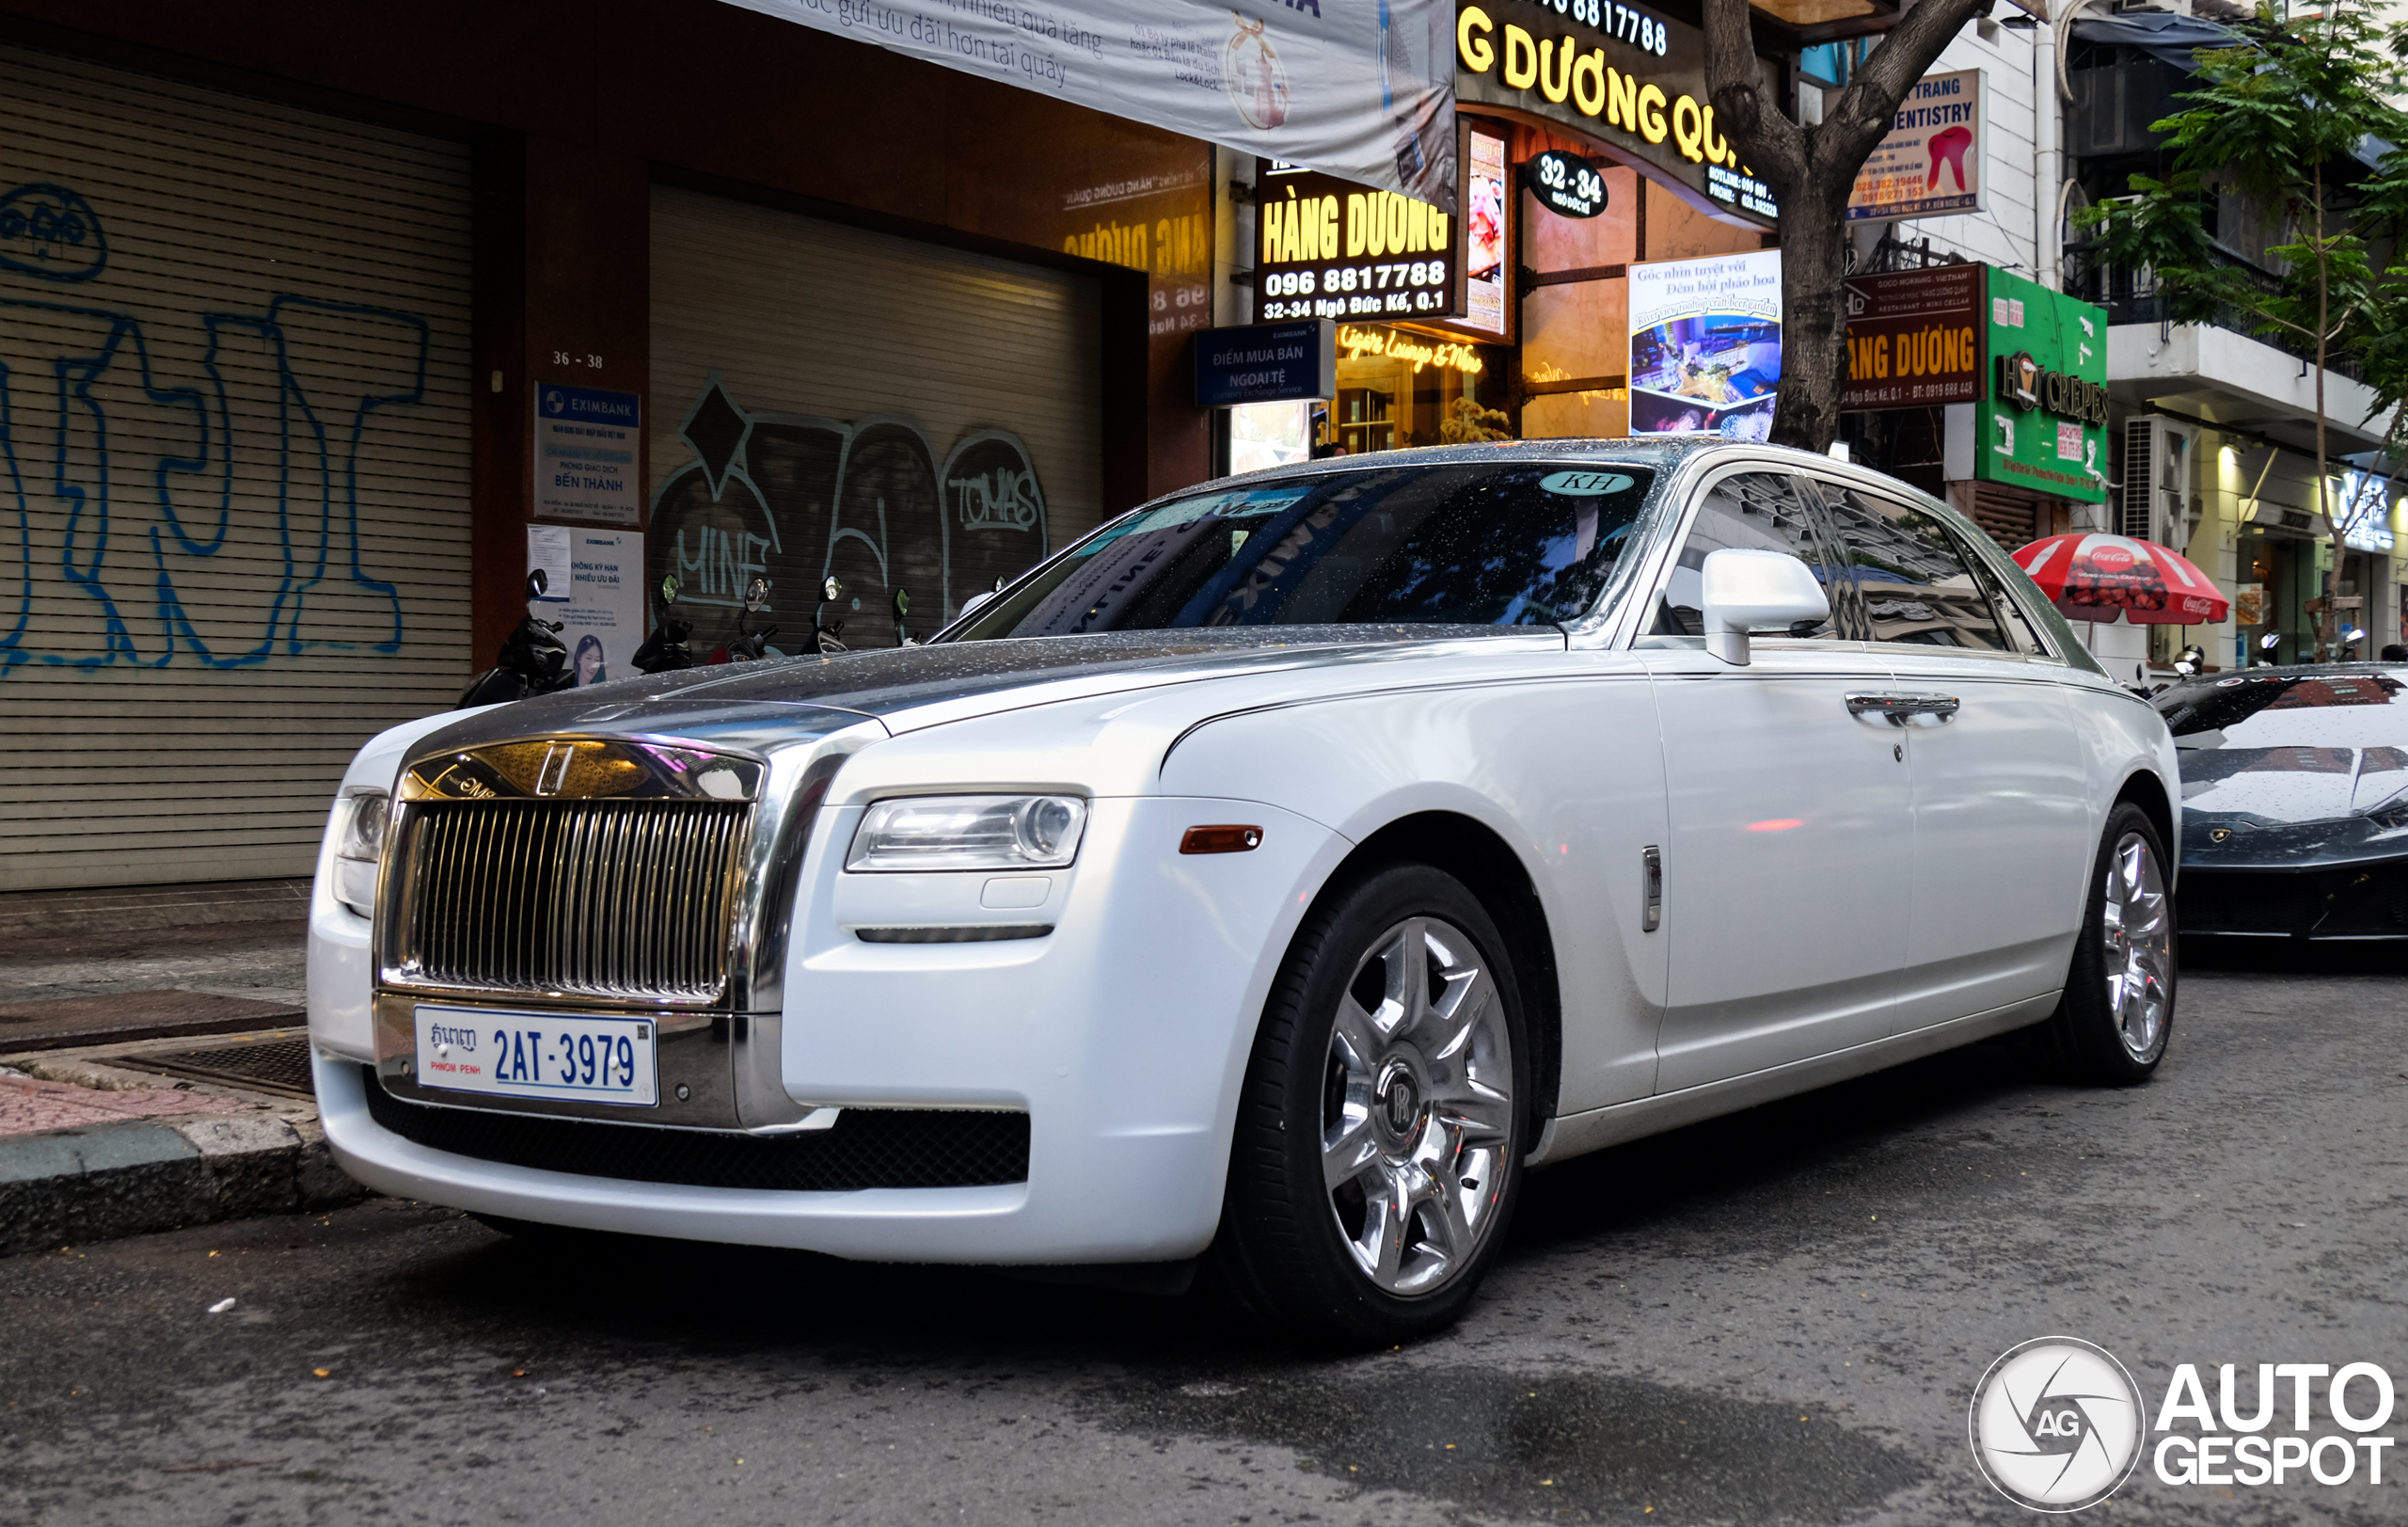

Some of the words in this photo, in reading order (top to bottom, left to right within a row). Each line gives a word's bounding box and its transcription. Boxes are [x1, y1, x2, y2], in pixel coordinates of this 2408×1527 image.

[1022, 12, 1057, 39] quà
[1063, 21, 1103, 59] tặng
[1171, 37, 1186, 50] pha
[878, 8, 904, 35] ưu
[911, 12, 943, 46] đãi
[947, 23, 986, 58] hơn
[991, 40, 1016, 72] tại
[1021, 52, 1068, 88] quầy
[1504, 24, 1668, 144] DƯƠNG
[1673, 95, 1753, 176] QU
[1915, 78, 1960, 100] TRANG
[1541, 155, 1565, 189] 32
[1577, 168, 1602, 204] 34
[1263, 185, 1339, 263] HÀNG
[1266, 271, 1315, 296] 096
[1323, 261, 1445, 292] 8817788
[1752, 275, 1776, 286] hoa
[1264, 301, 1311, 319] 32-34
[1316, 298, 1345, 318] Ngô
[1350, 295, 1382, 313] Đức
[1386, 292, 1411, 312] Kế,
[1417, 291, 1444, 310] Q.1
[1273, 330, 1307, 339] EXIMBANK
[553, 351, 569, 366] 36
[587, 354, 603, 369] 38
[1213, 347, 1244, 366] ĐIỂM
[1246, 349, 1275, 363] MUA
[1277, 344, 1304, 360] BÁN
[1385, 330, 1433, 374] Lounge
[1847, 327, 1889, 380] ÀNG
[1896, 324, 1974, 376] DƯƠNG
[1229, 372, 1268, 388] NGOẠI
[1271, 368, 1286, 386] TỆ
[1925, 384, 1943, 398] 0919
[572, 398, 631, 417] EXIMBANK
[555, 471, 580, 488] BẾN
[583, 474, 623, 492] THÀNH
[1558, 473, 1619, 490] KH
[431, 1061, 456, 1073] PHNOM
[460, 1064, 481, 1074] PENH
